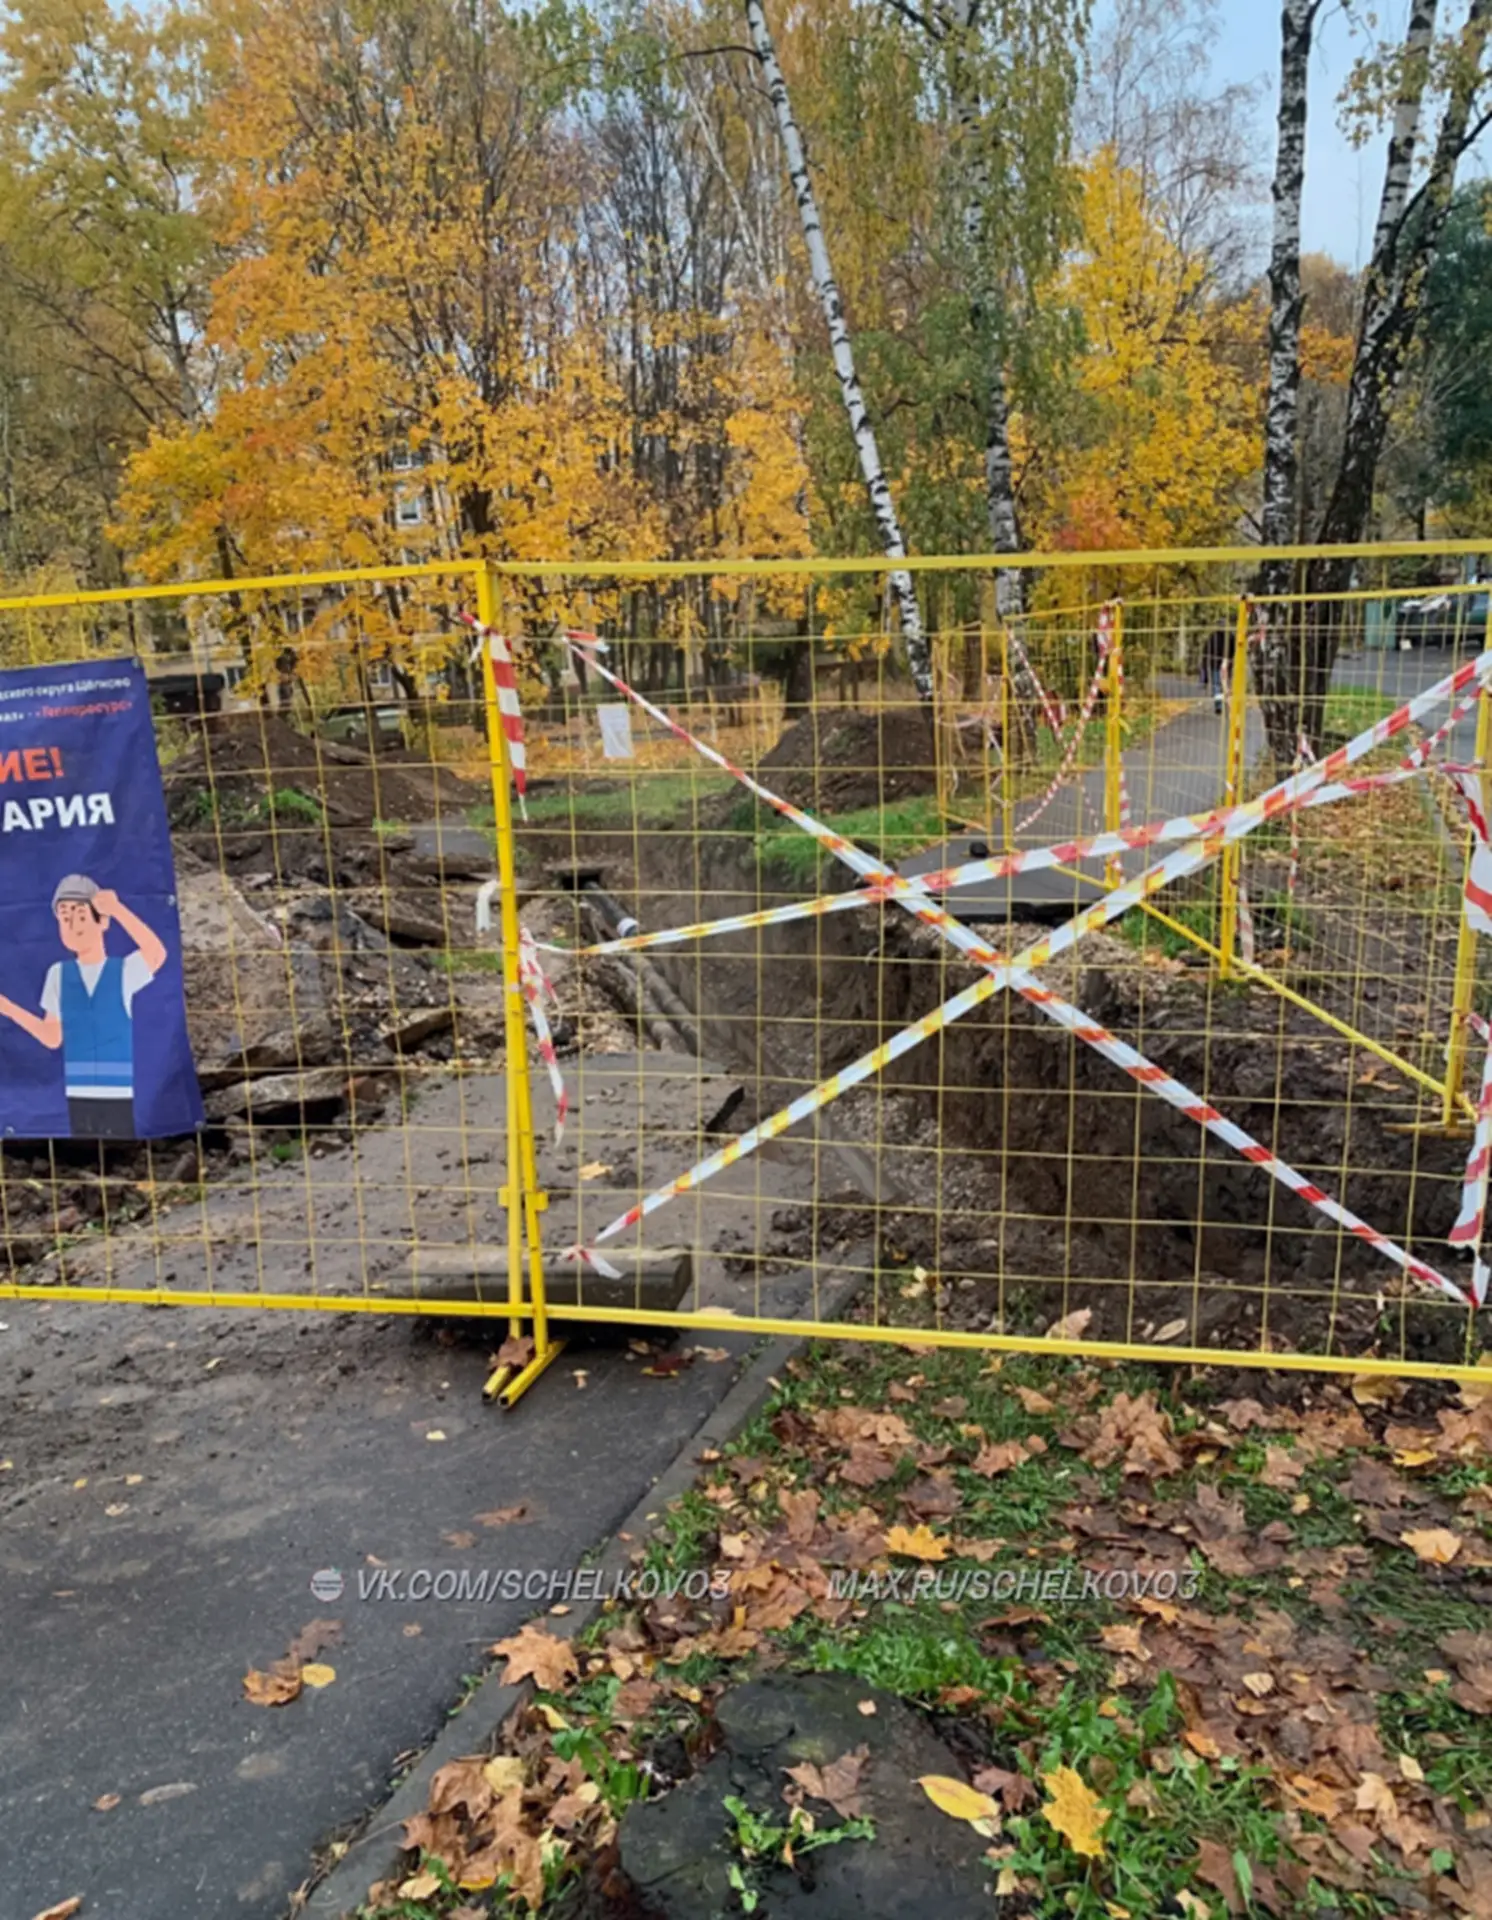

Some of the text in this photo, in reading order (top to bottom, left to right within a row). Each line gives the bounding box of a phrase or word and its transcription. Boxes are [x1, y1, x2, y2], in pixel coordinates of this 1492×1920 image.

[35, 682, 74, 697] округа
[0, 746, 64, 784] ИЕ!
[2, 792, 115, 832] АРИЯ
